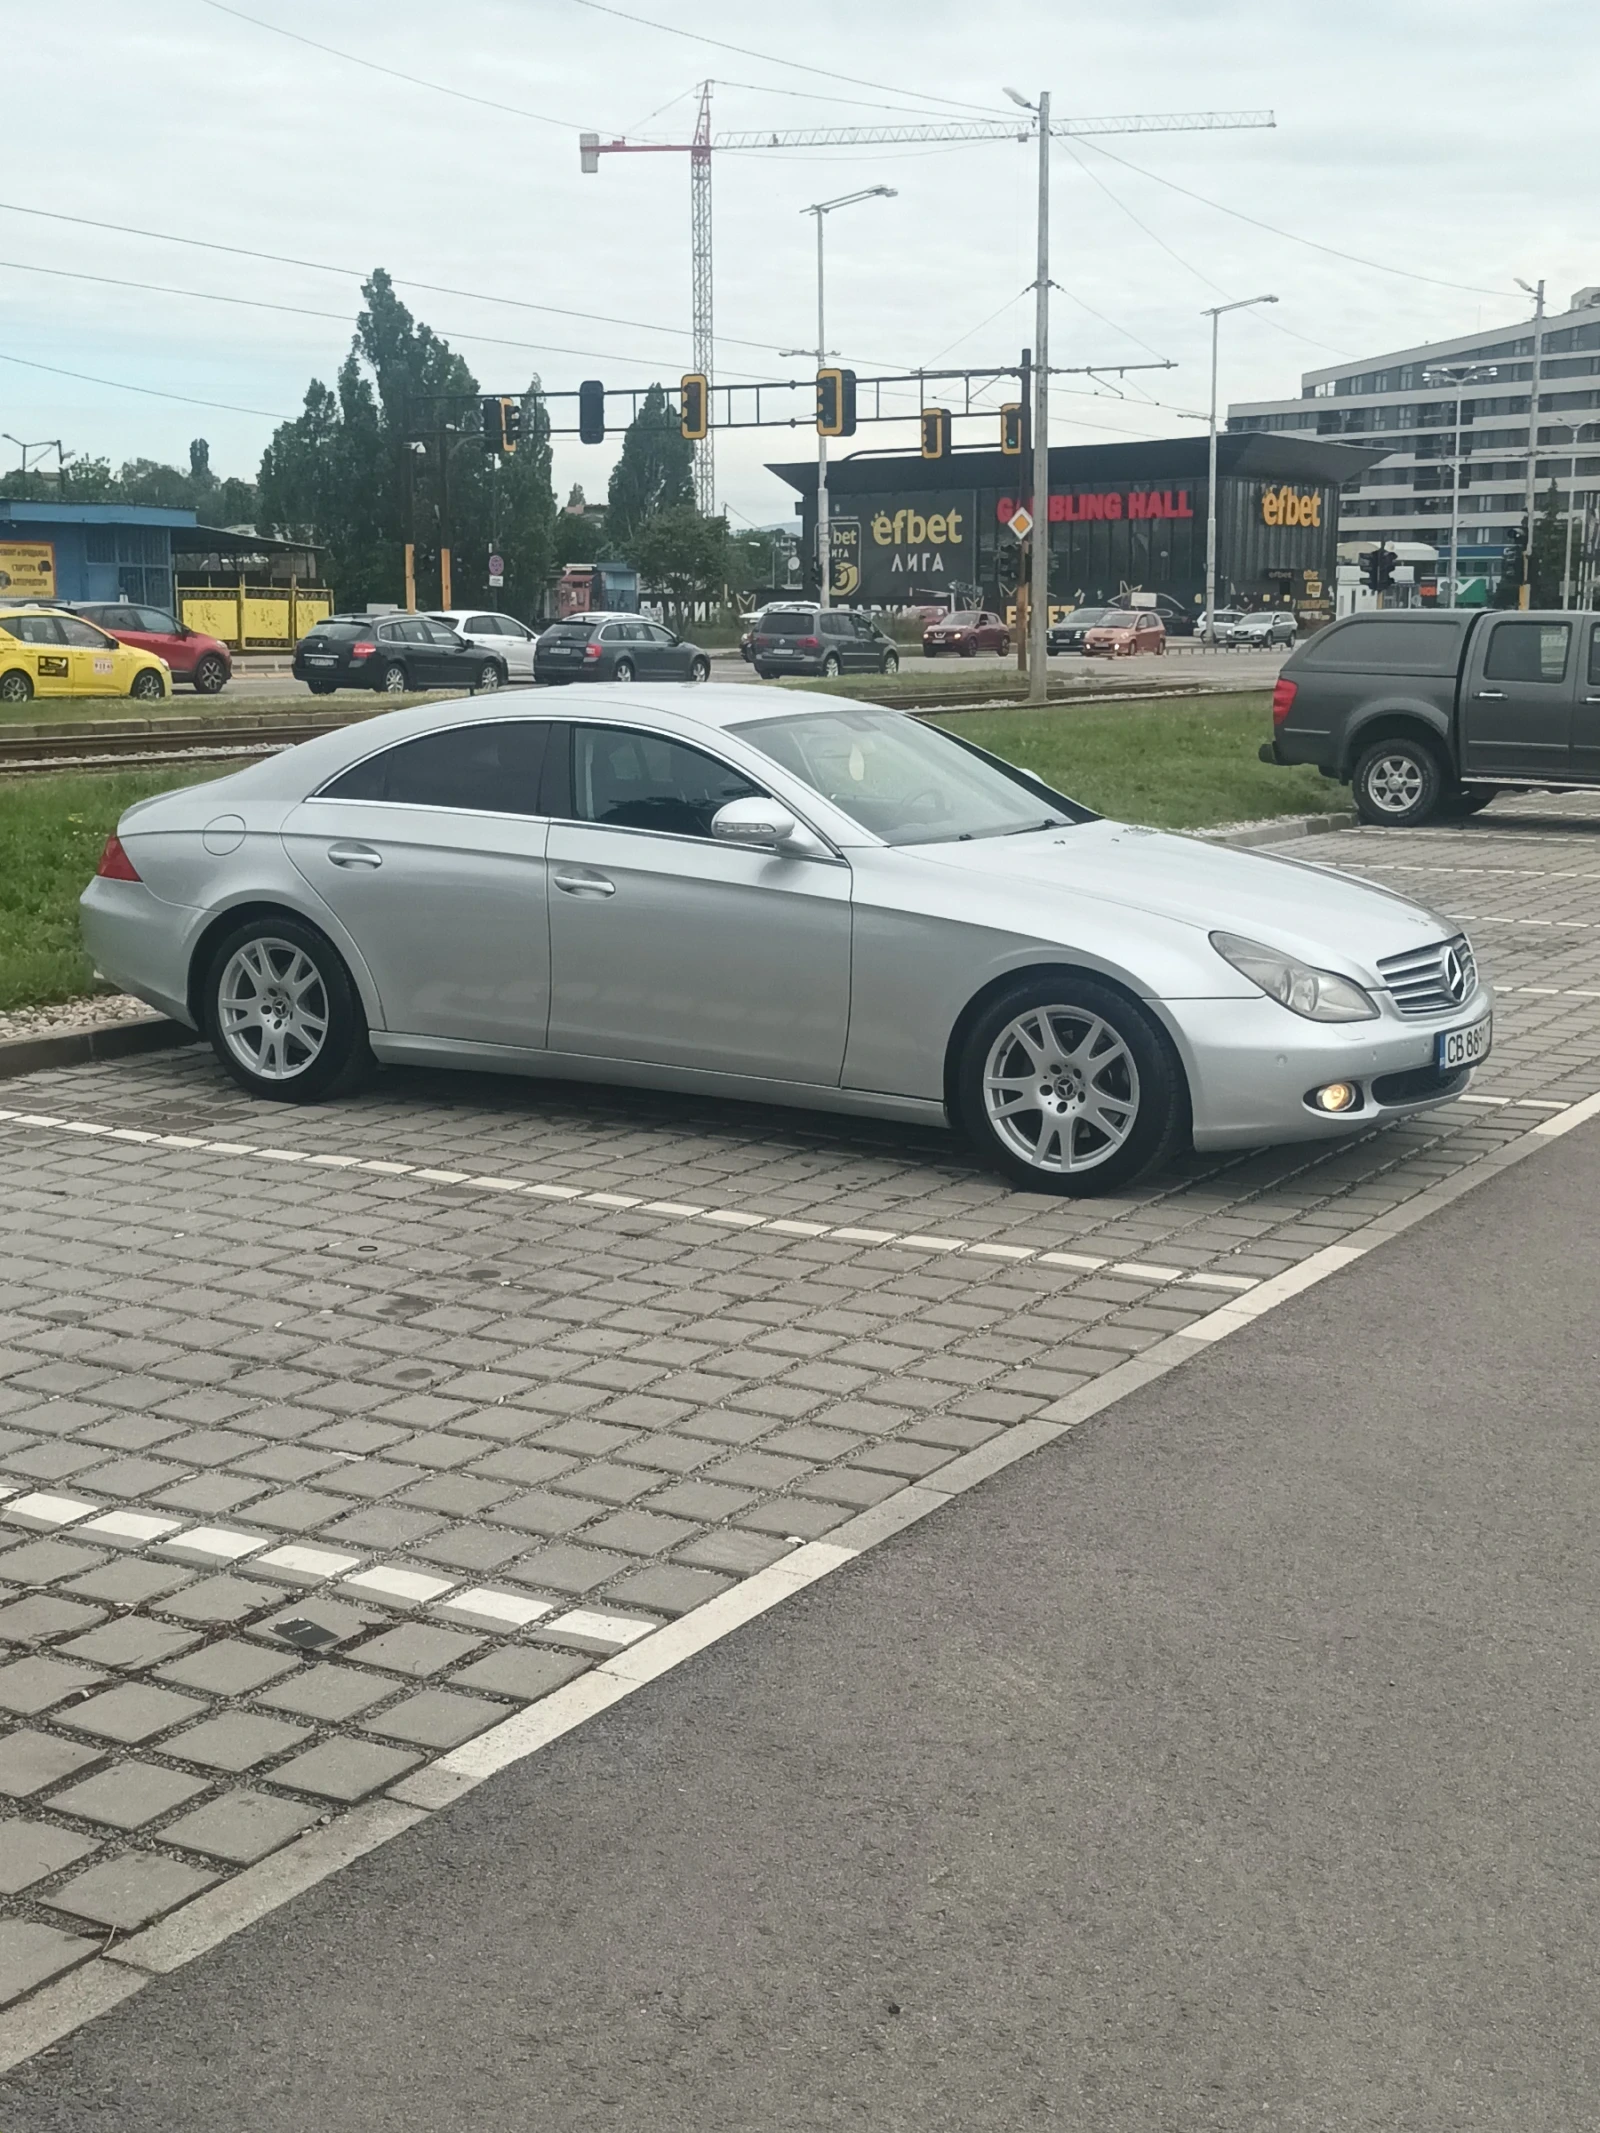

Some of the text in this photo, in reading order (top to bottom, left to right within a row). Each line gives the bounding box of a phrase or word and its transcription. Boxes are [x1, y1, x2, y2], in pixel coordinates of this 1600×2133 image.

[997, 489, 1193, 523] GBLING HALL
[1262, 486, 1321, 527] efbet
[872, 508, 962, 545] efbet
[891, 553, 944, 572] ЛИГА
[1448, 1034, 1464, 1063] CB
